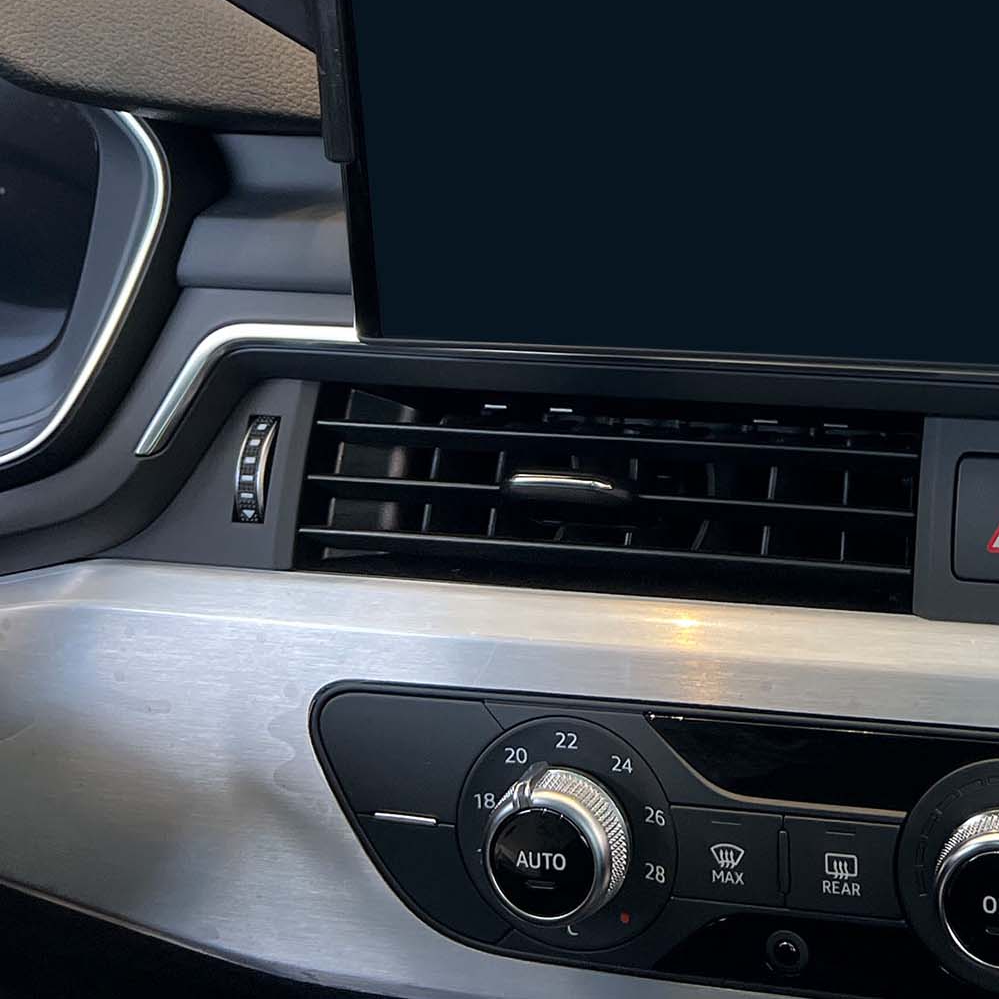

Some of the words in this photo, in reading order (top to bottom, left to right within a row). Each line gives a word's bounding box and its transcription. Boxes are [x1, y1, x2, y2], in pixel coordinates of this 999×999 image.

[555, 732, 579, 750] 22
[504, 747, 528, 764] 20
[611, 755, 633, 774] 24
[473, 792, 496, 810] 18
[644, 806, 666, 826] 26
[516, 850, 567, 871] AUTO
[644, 863, 666, 883] 28
[712, 870, 745, 885] MAX
[822, 880, 861, 897] REAR
